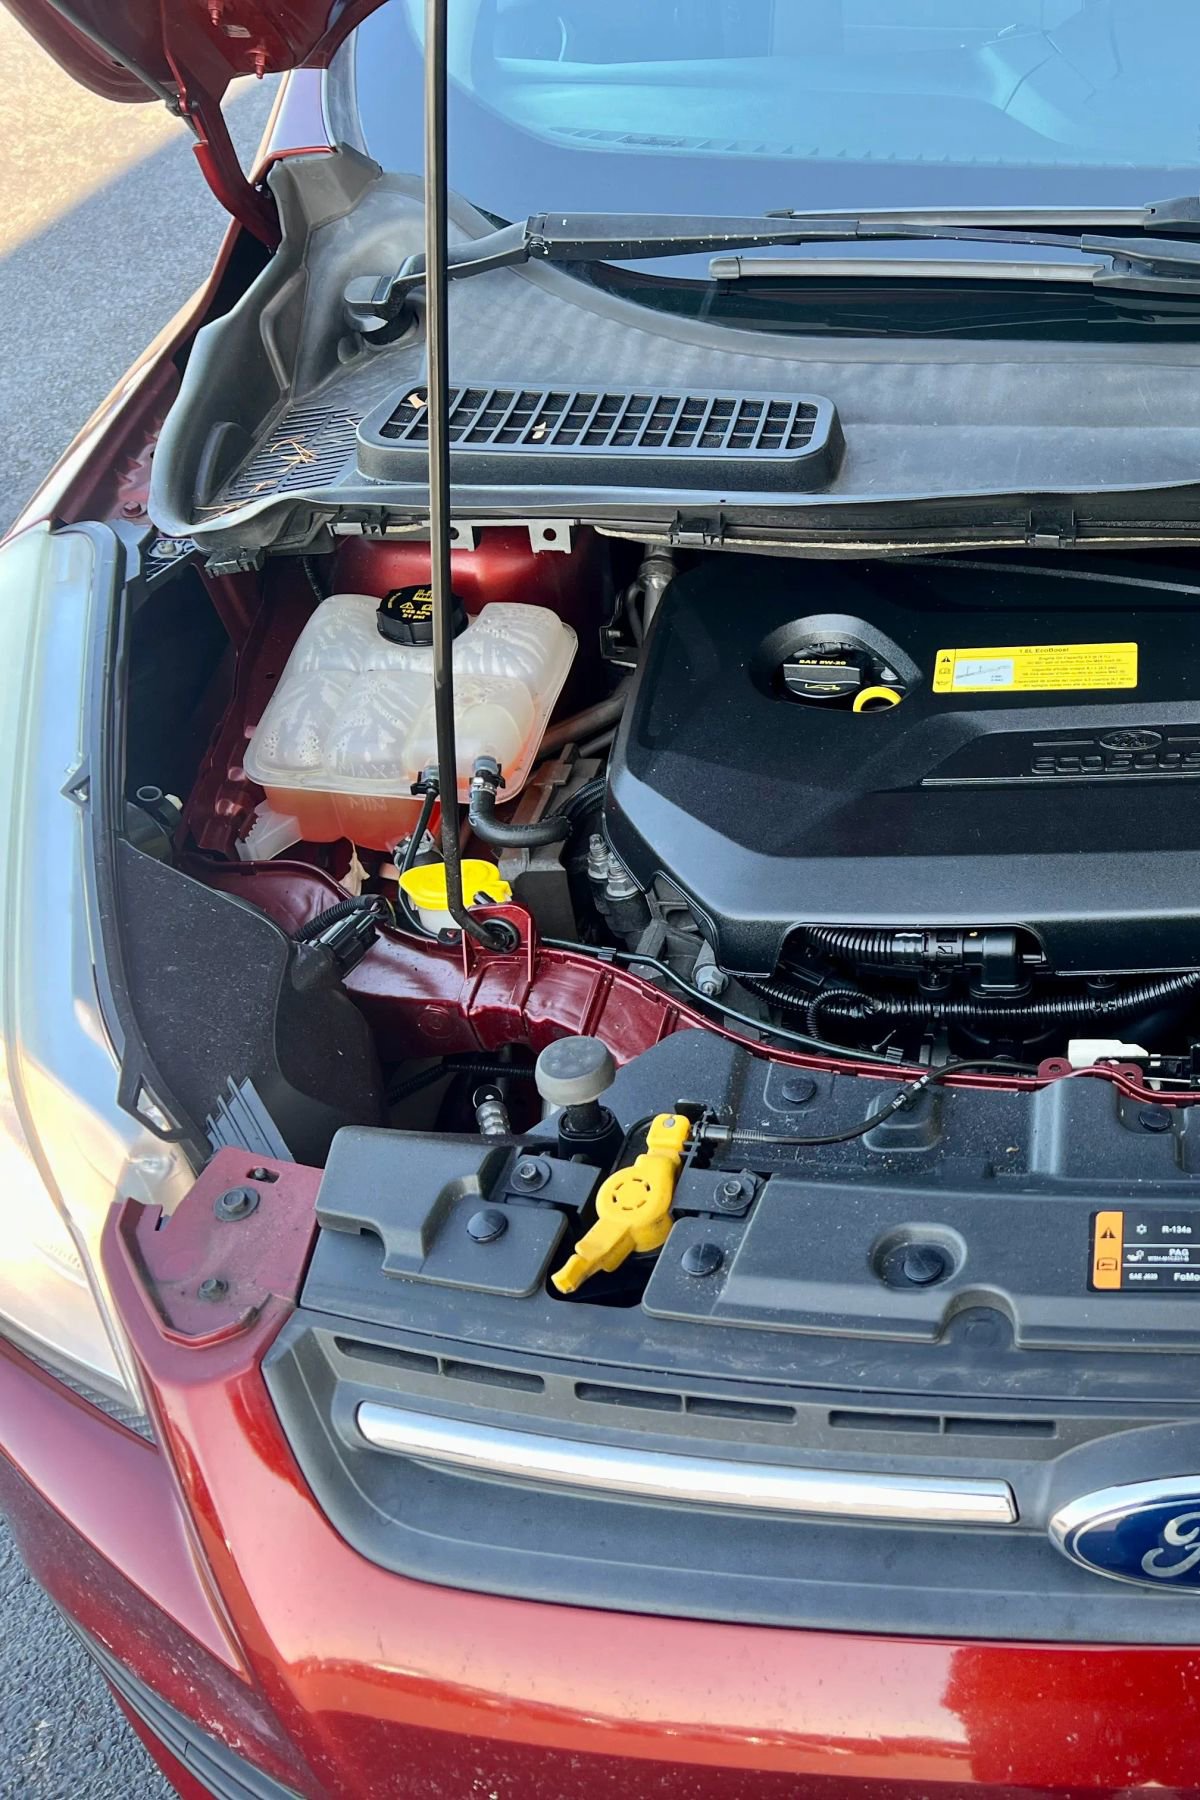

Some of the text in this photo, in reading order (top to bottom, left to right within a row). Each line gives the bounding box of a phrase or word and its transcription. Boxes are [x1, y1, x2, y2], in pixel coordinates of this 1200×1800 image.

[1161, 1225, 1192, 1234] R-134a
[1168, 1248, 1190, 1256] PAG
[1128, 1272, 1143, 1280] SAE
